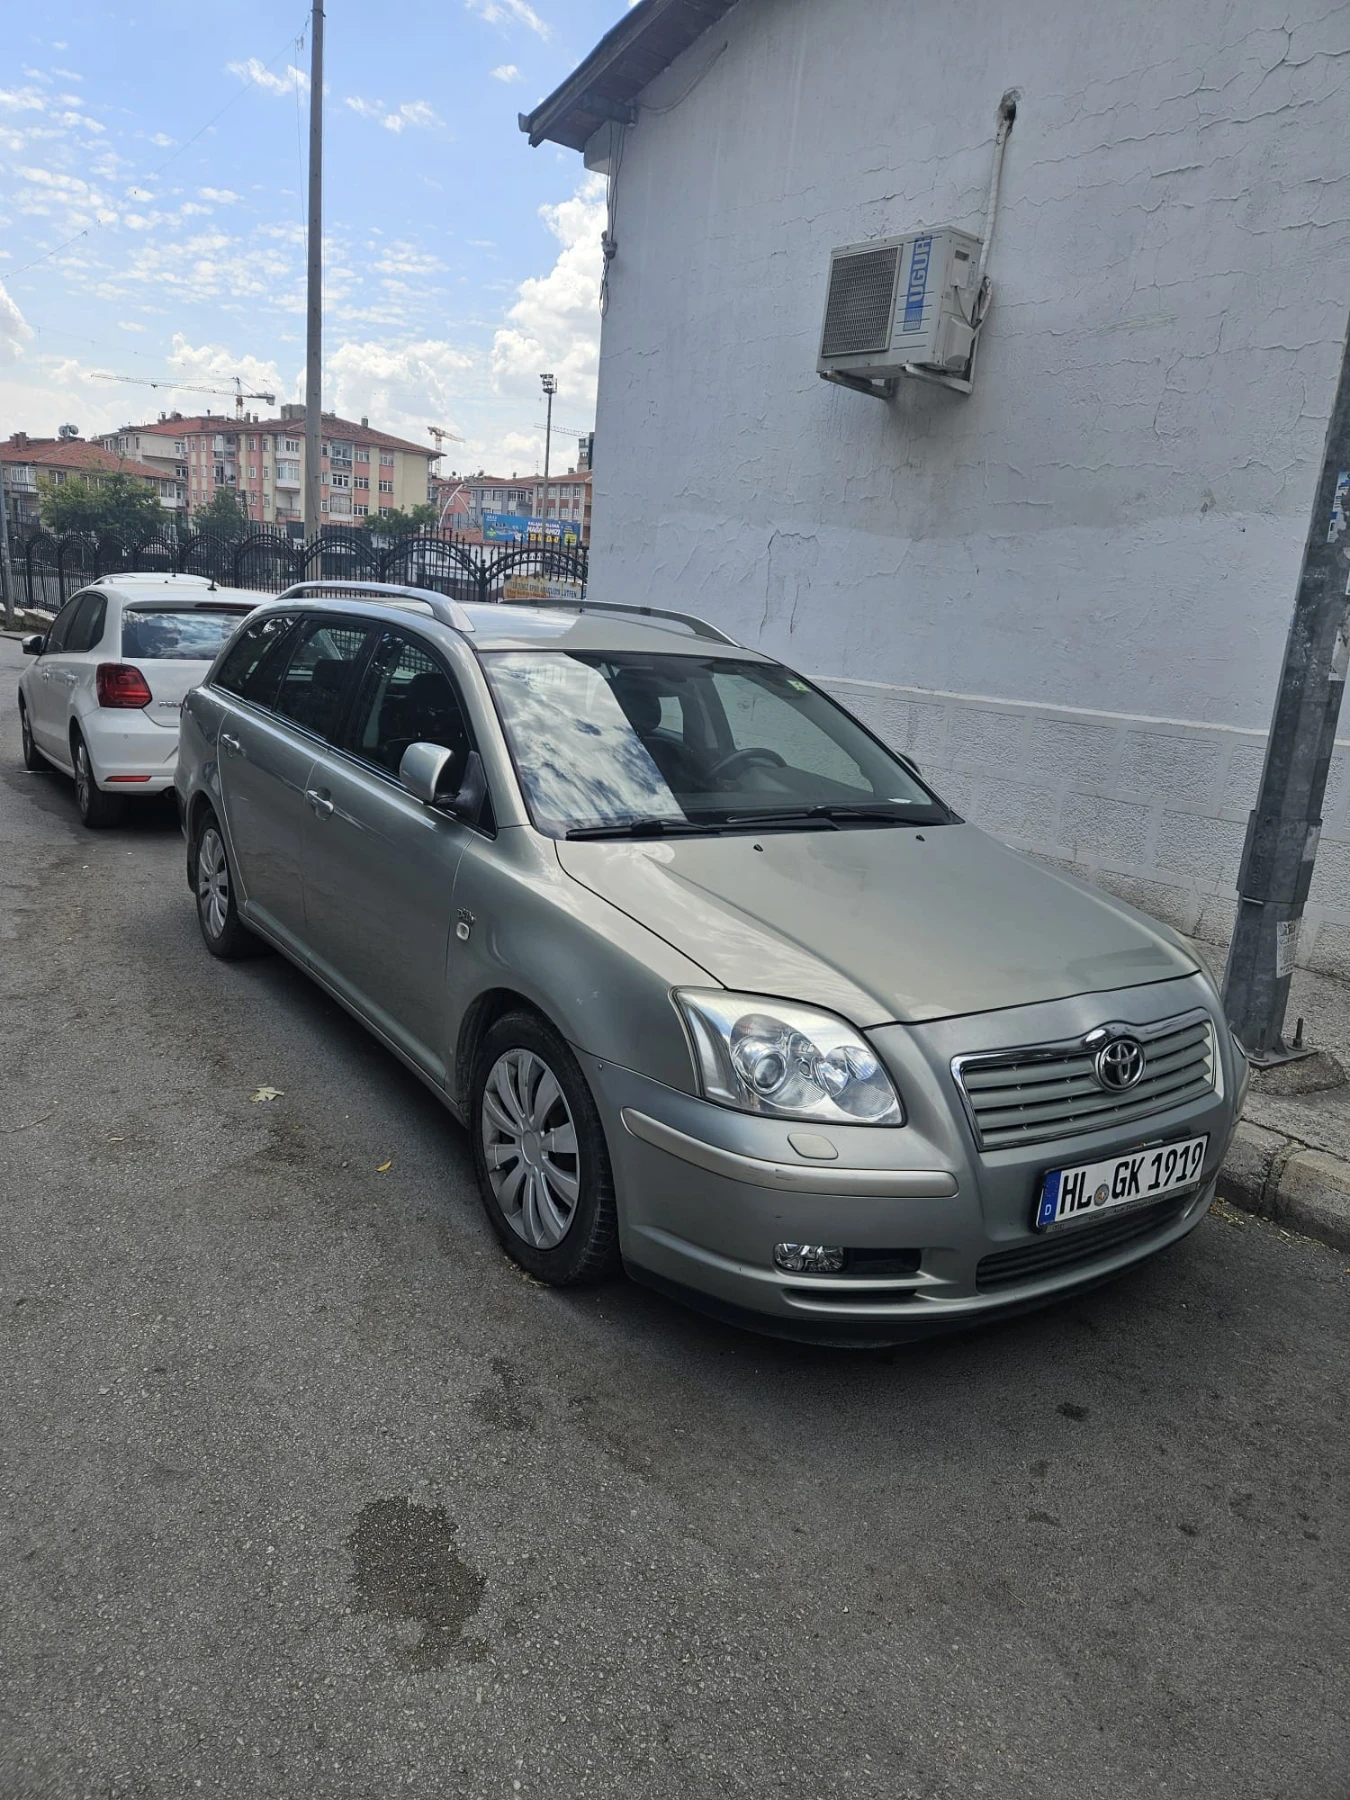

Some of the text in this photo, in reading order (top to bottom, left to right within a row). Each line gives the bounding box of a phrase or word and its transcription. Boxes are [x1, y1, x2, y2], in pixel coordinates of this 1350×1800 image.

[1059, 1141, 1204, 1214] HL GK 1919
[1044, 1204, 1051, 1215] D
